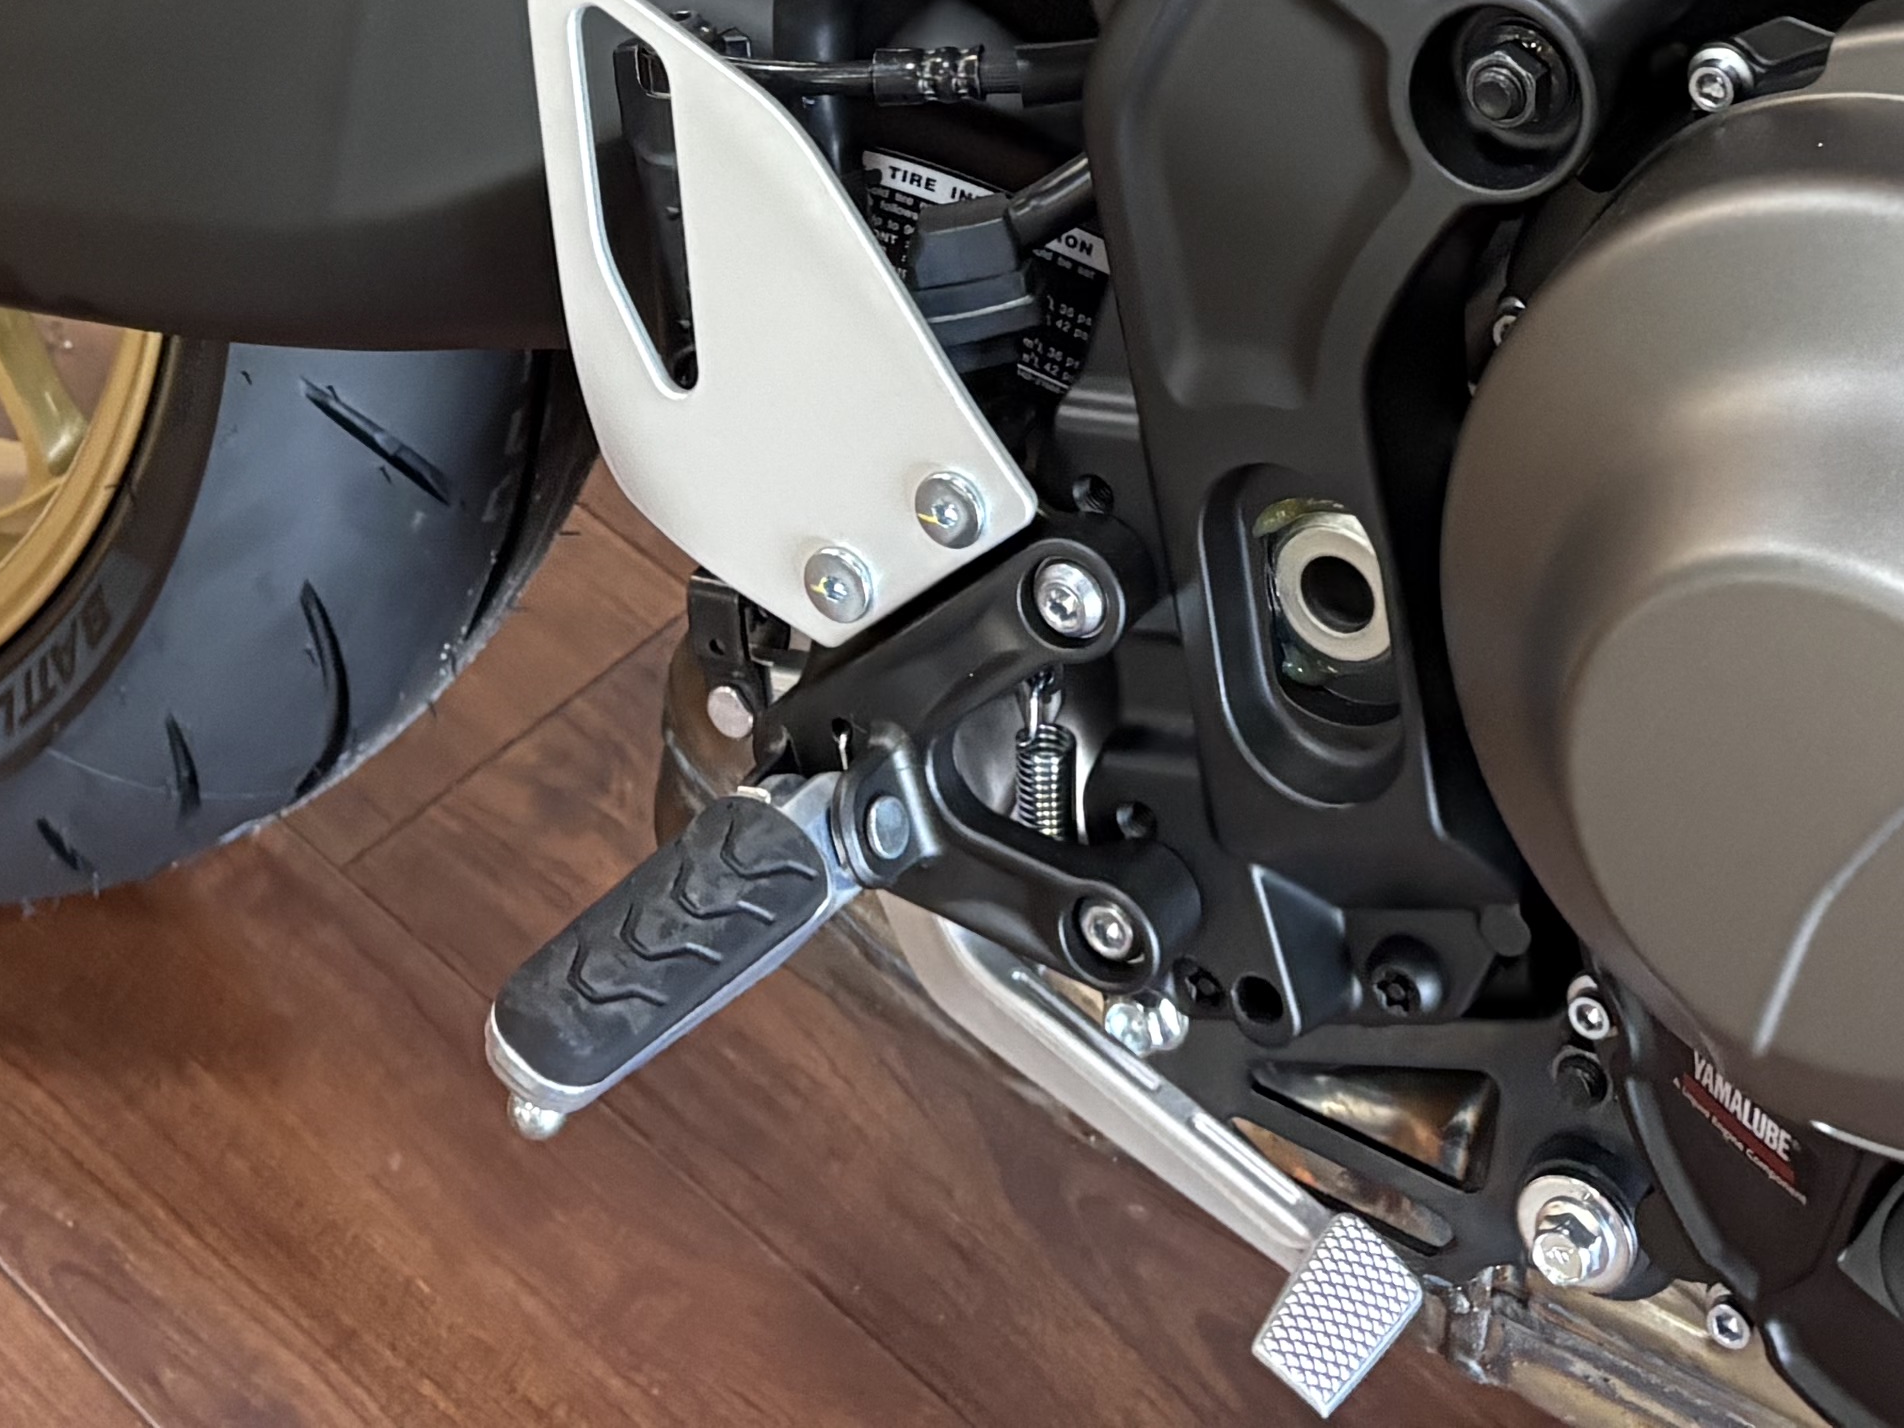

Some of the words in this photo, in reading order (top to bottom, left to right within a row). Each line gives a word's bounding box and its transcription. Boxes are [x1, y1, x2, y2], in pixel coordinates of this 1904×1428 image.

[889, 165, 937, 193] TIRE
[1055, 319, 1072, 333] 42
[1043, 362, 1060, 377] 42
[1693, 1049, 1793, 1163] YAMALUBE
